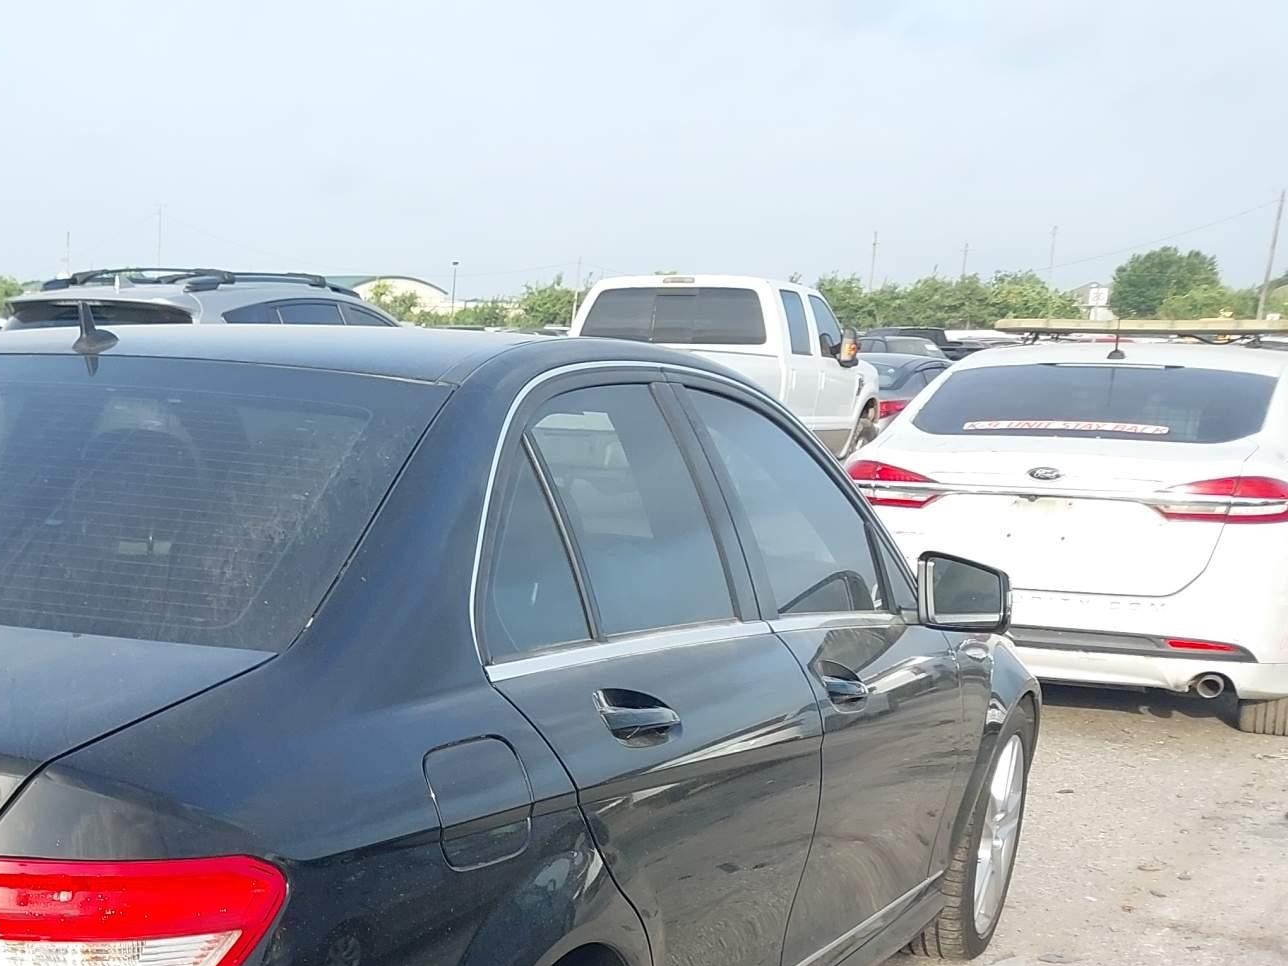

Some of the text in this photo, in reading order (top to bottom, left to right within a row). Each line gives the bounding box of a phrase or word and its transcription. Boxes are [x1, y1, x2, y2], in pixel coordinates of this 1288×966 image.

[967, 421, 1167, 433] K-9 UNIT STAY BACK
